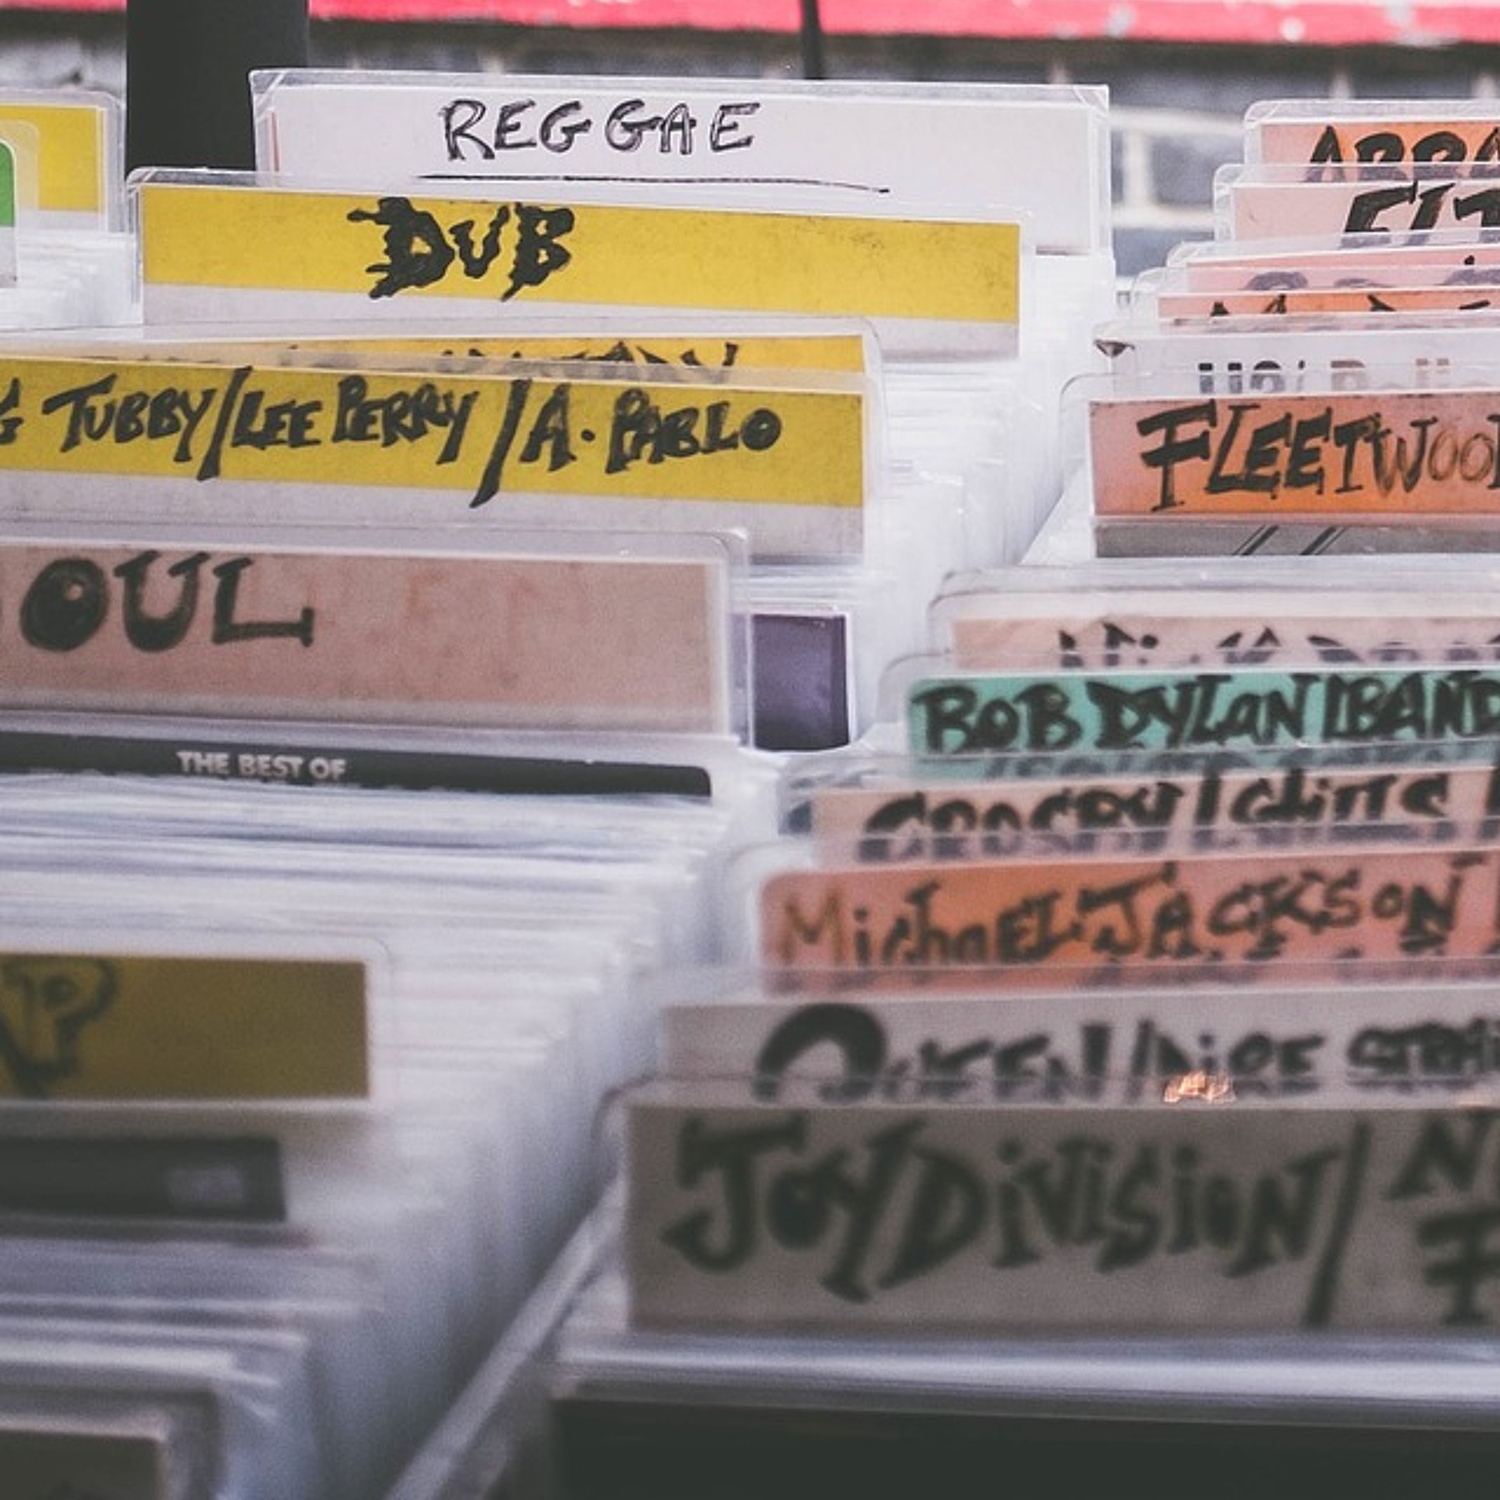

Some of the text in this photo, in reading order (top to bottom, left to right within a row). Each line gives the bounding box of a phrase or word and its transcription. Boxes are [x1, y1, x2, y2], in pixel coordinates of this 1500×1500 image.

[440, 99, 760, 161] REGGAE
[347, 196, 576, 300] DUB
[605, 388, 782, 474] PABLO
[20, 551, 314, 652] OUL
[910, 683, 1082, 756] BOB
[176, 751, 346, 782] THE BEST OF
